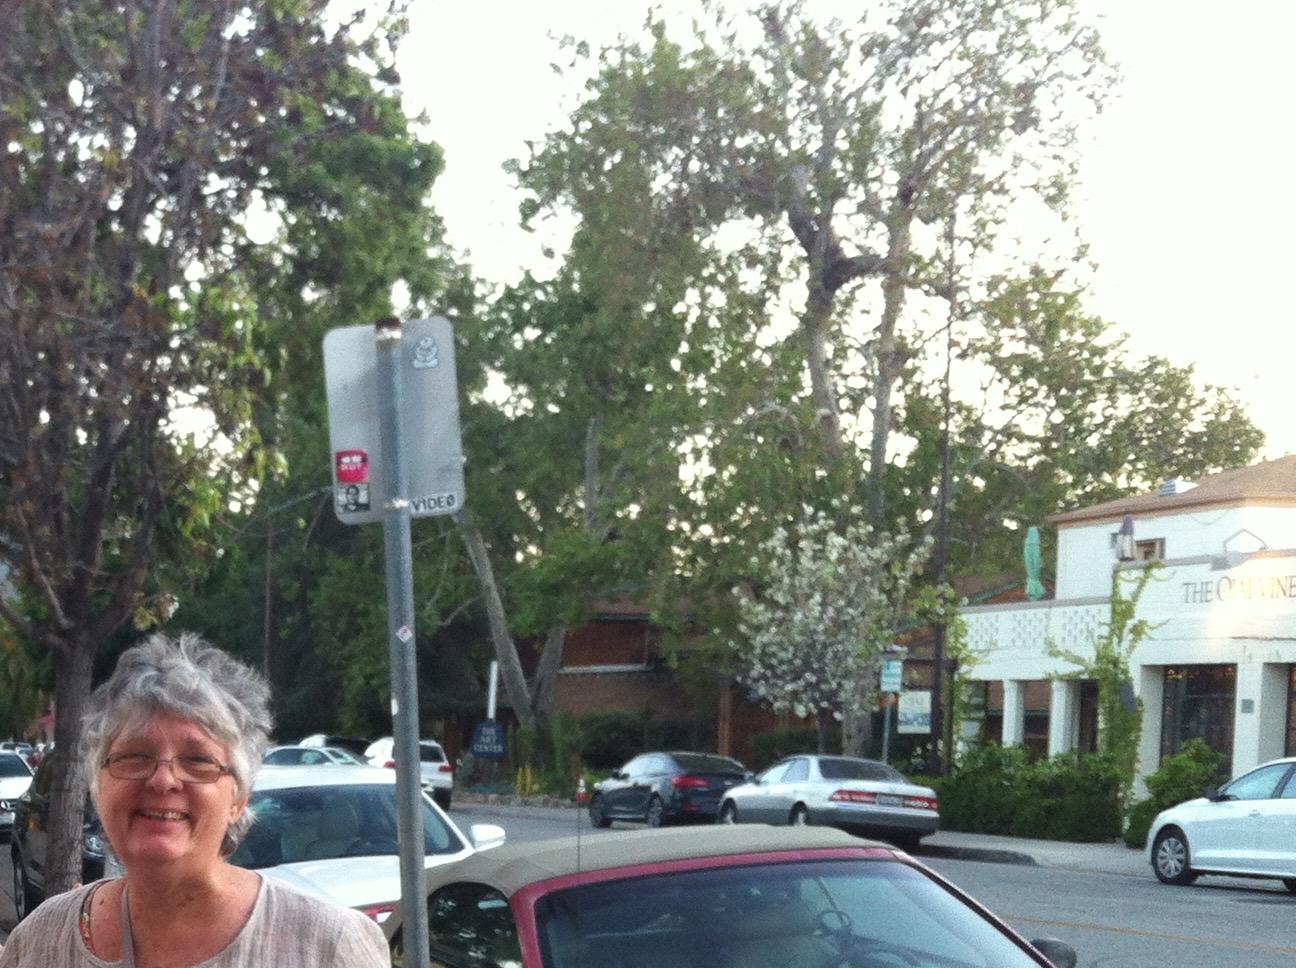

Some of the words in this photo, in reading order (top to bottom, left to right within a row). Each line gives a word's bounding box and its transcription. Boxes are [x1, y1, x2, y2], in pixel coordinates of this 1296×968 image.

[412, 494, 455, 511] VIDEO
[1183, 581, 1214, 604] THE
[481, 735, 497, 744] ART
[473, 744, 503, 752] CENTER
